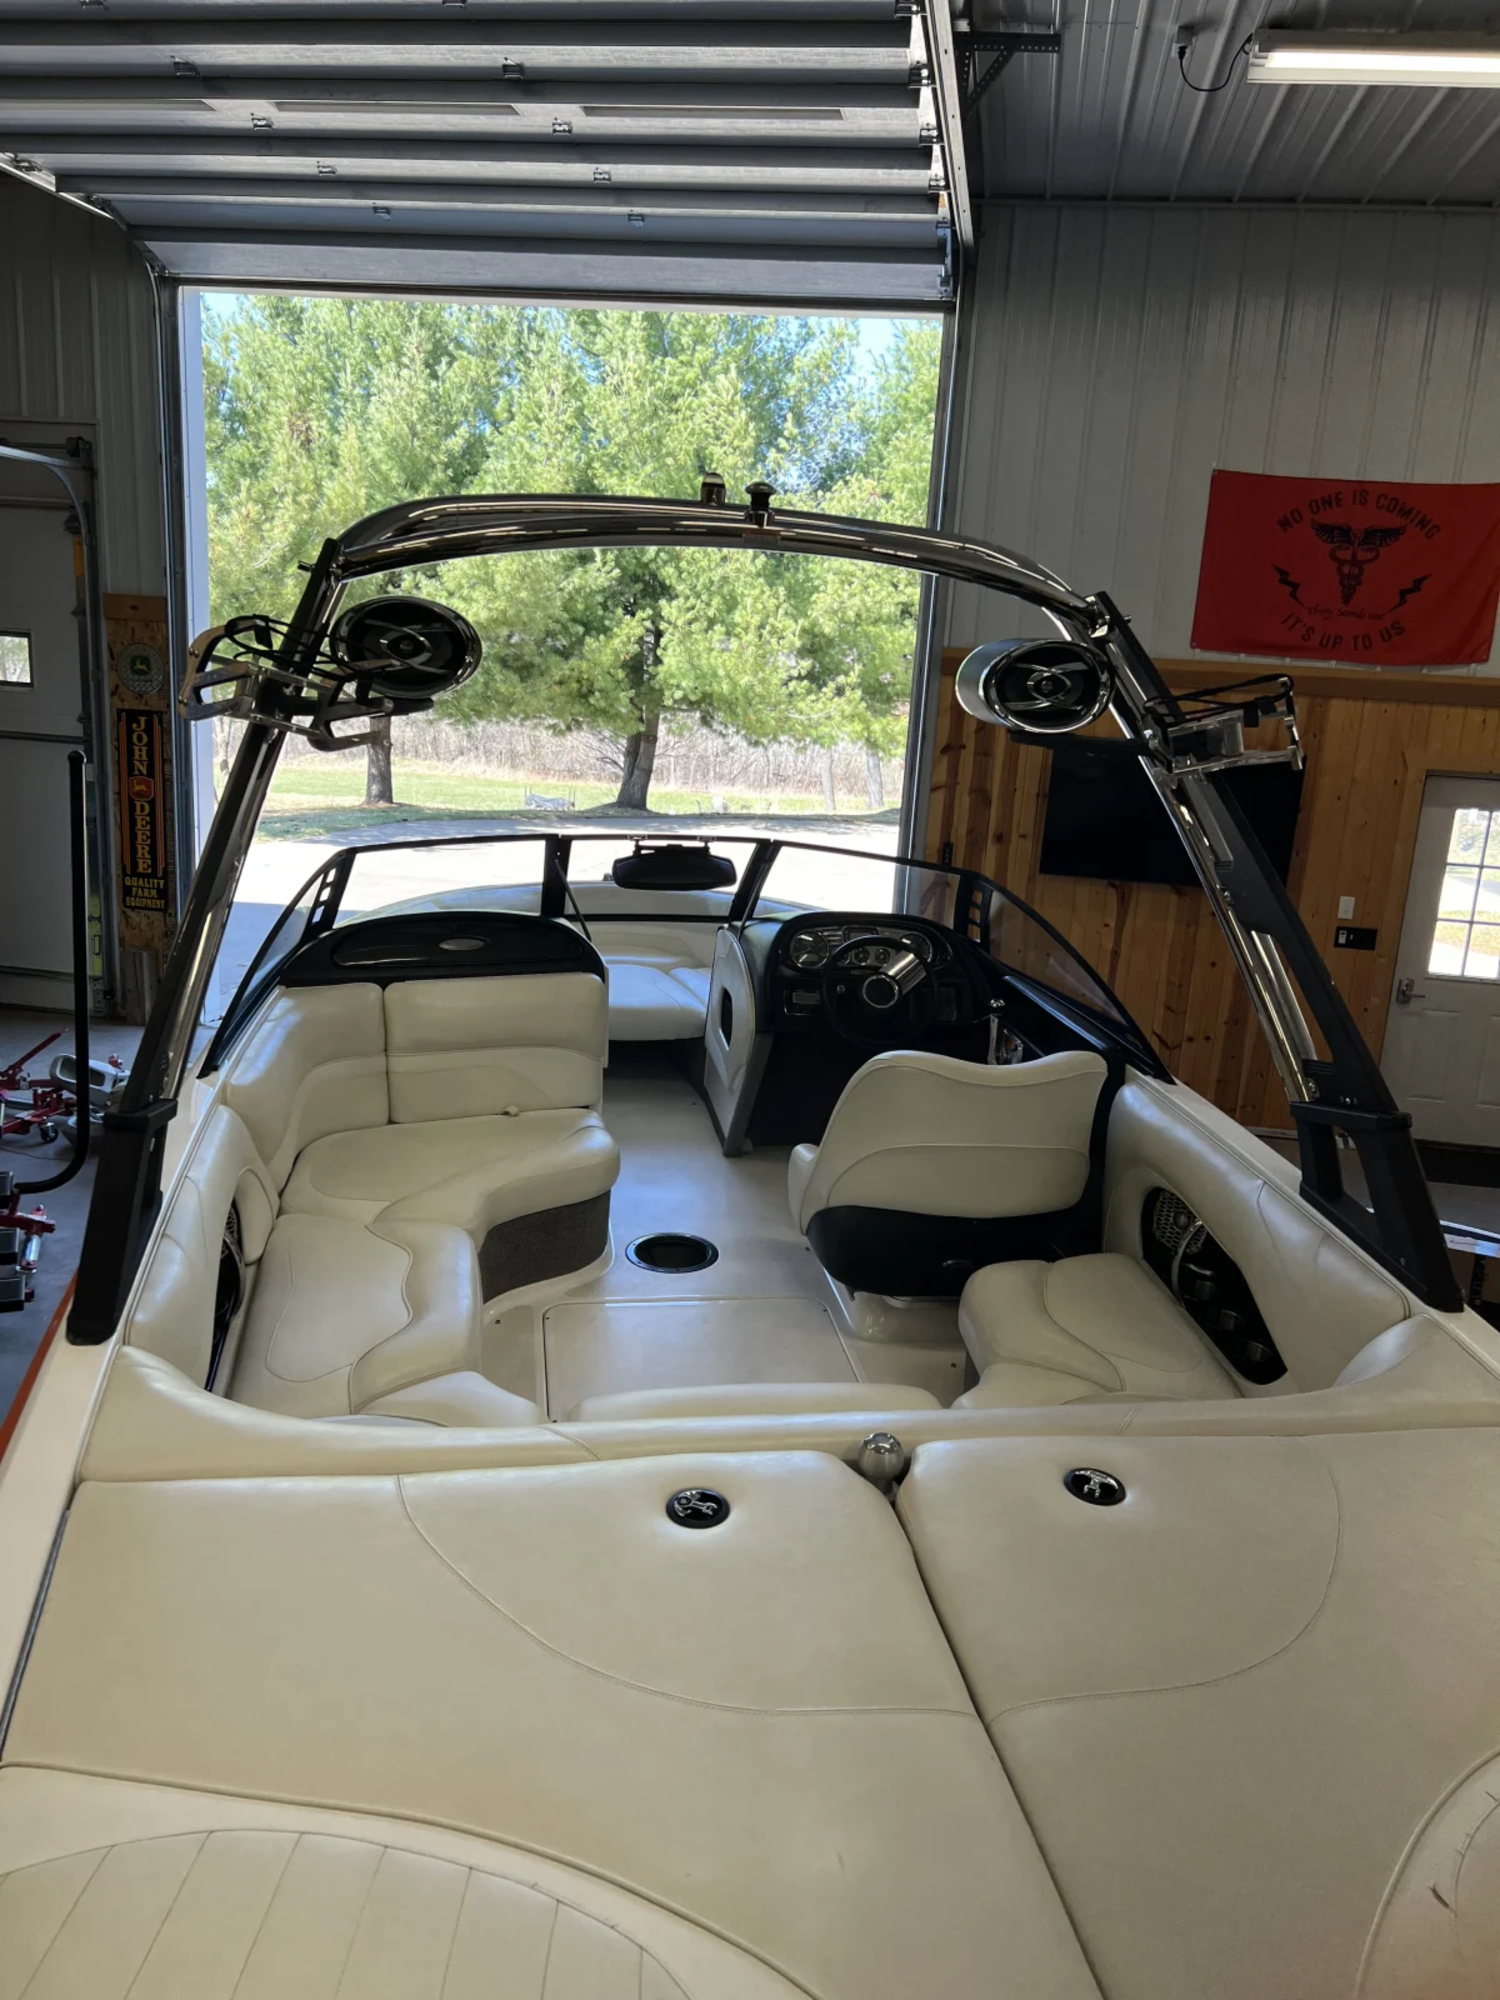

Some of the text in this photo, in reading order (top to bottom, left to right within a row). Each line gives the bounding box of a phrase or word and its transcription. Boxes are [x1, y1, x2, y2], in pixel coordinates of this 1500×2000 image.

[1277, 489, 1441, 540] NO ONE IS COMING
[1280, 612, 1405, 651] IT'S UP TO US
[131, 716, 149, 776] JOHN
[134, 801, 153, 875] DEERE
[124, 875, 165, 890] QUALITY
[131, 887, 158, 899] FARM
[125, 896, 166, 909] EQUIPMENT
